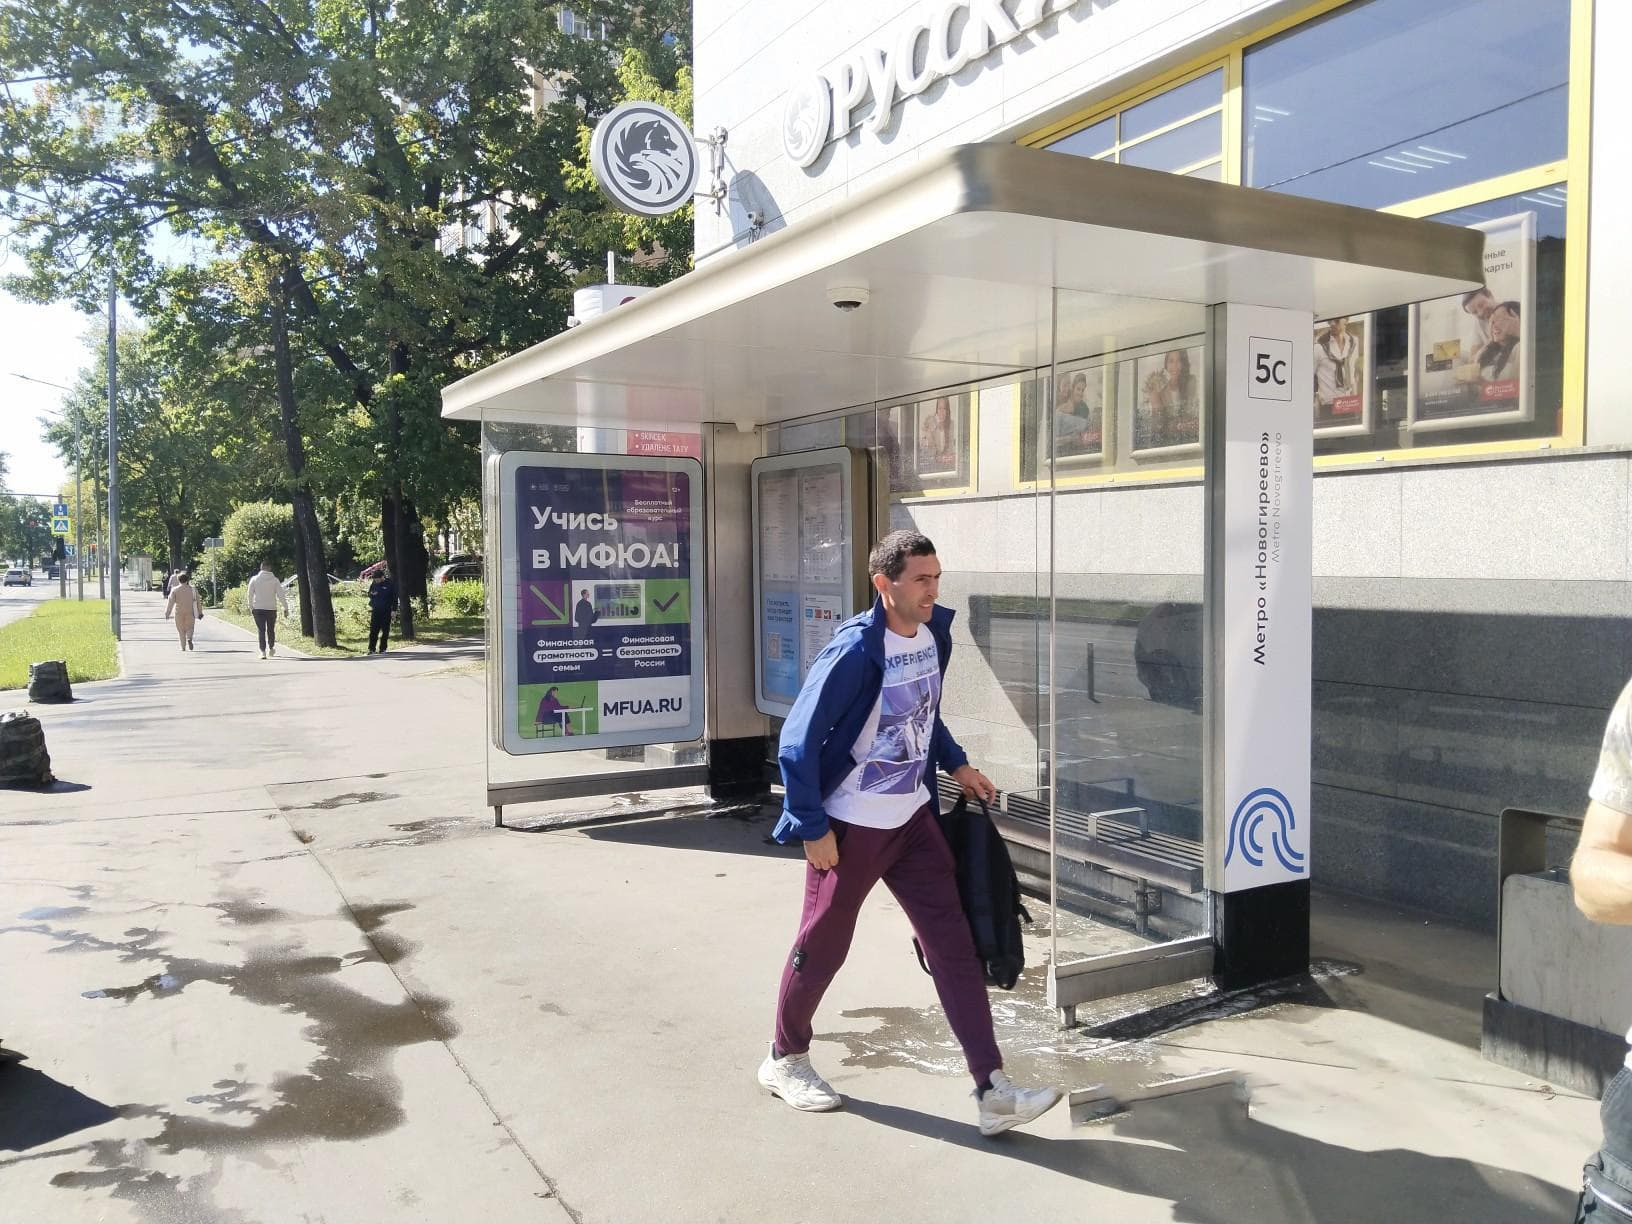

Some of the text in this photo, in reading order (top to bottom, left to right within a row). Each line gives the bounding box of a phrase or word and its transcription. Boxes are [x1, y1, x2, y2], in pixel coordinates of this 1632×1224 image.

[1272, 432, 1283, 563] Metro Novogireevo
[531, 506, 618, 531] Учись
[532, 543, 680, 569] в МФЮА!
[1253, 432, 1270, 666] Метро «Новогиреево»
[537, 639, 594, 648] Финансовая
[622, 635, 675, 644] Финансовая
[537, 652, 595, 661] грамотность
[619, 647, 680, 656] безопасность
[634, 659, 665, 668] России
[603, 697, 683, 717] MFUA.RU
